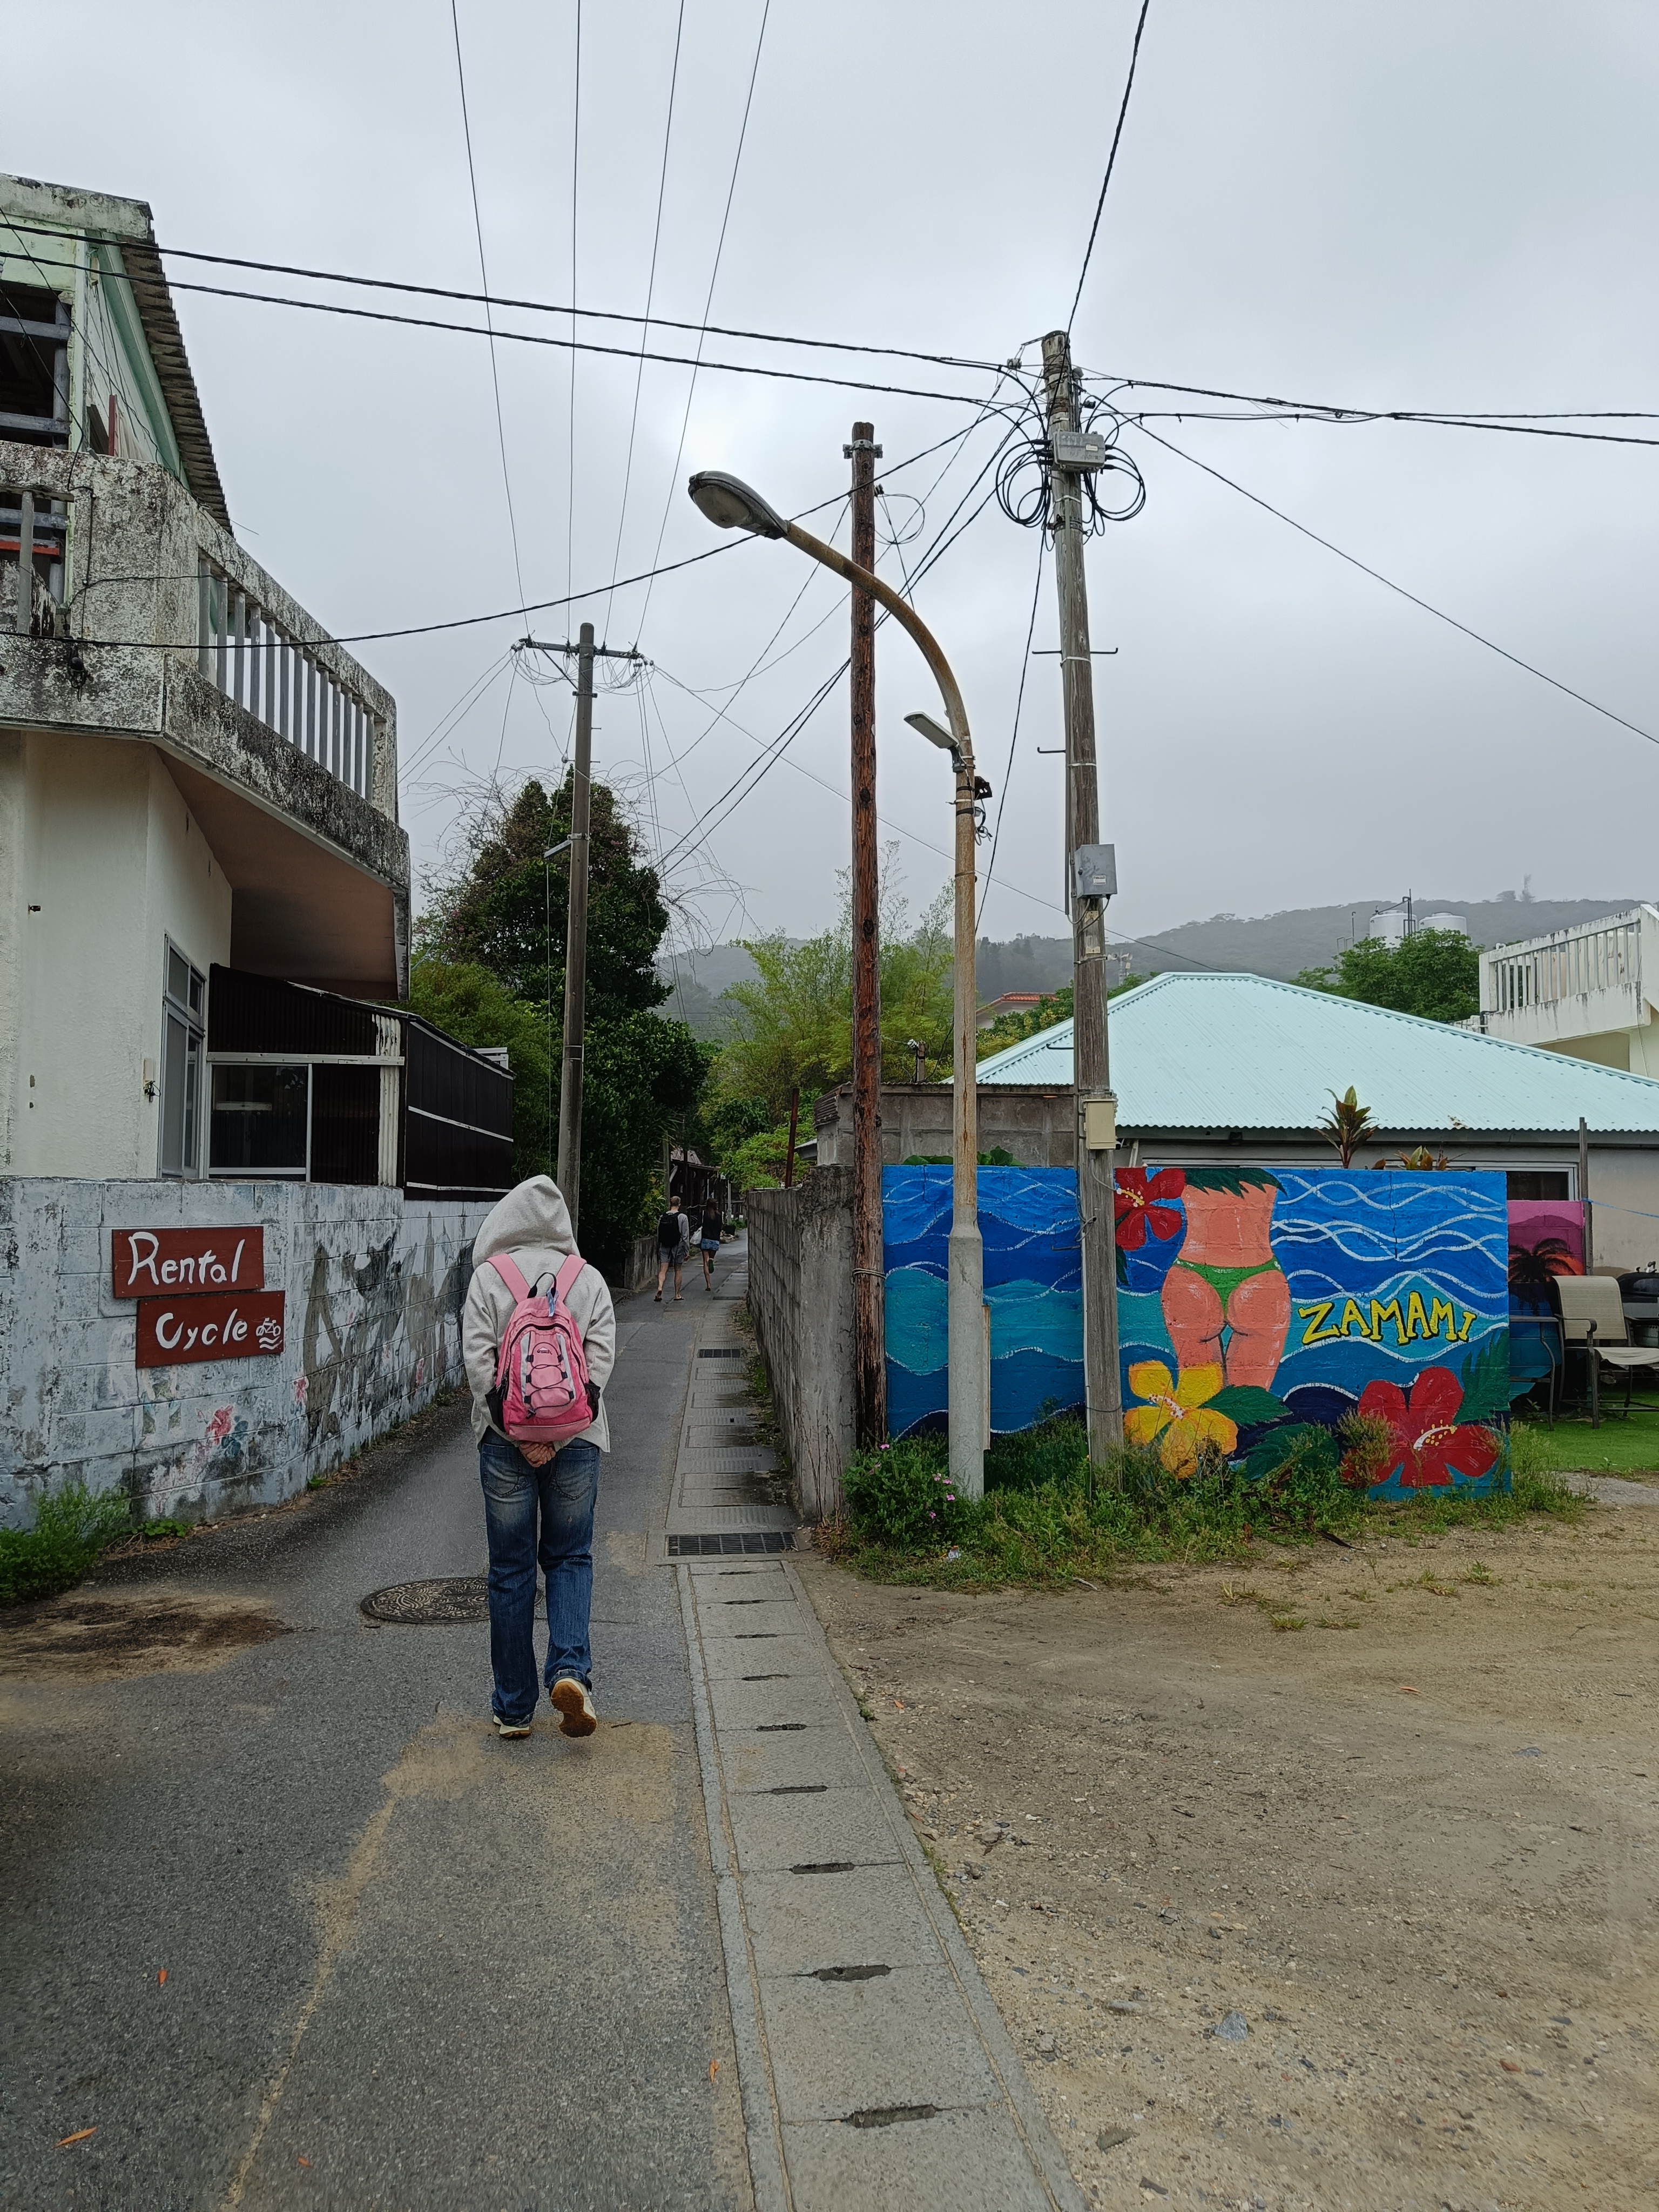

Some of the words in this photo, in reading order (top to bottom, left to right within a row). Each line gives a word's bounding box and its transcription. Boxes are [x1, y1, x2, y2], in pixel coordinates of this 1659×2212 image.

[127, 1231, 245, 1285] Rental
[156, 1308, 248, 1352] Cycle
[1298, 1291, 1478, 1345] ZAMAMI
